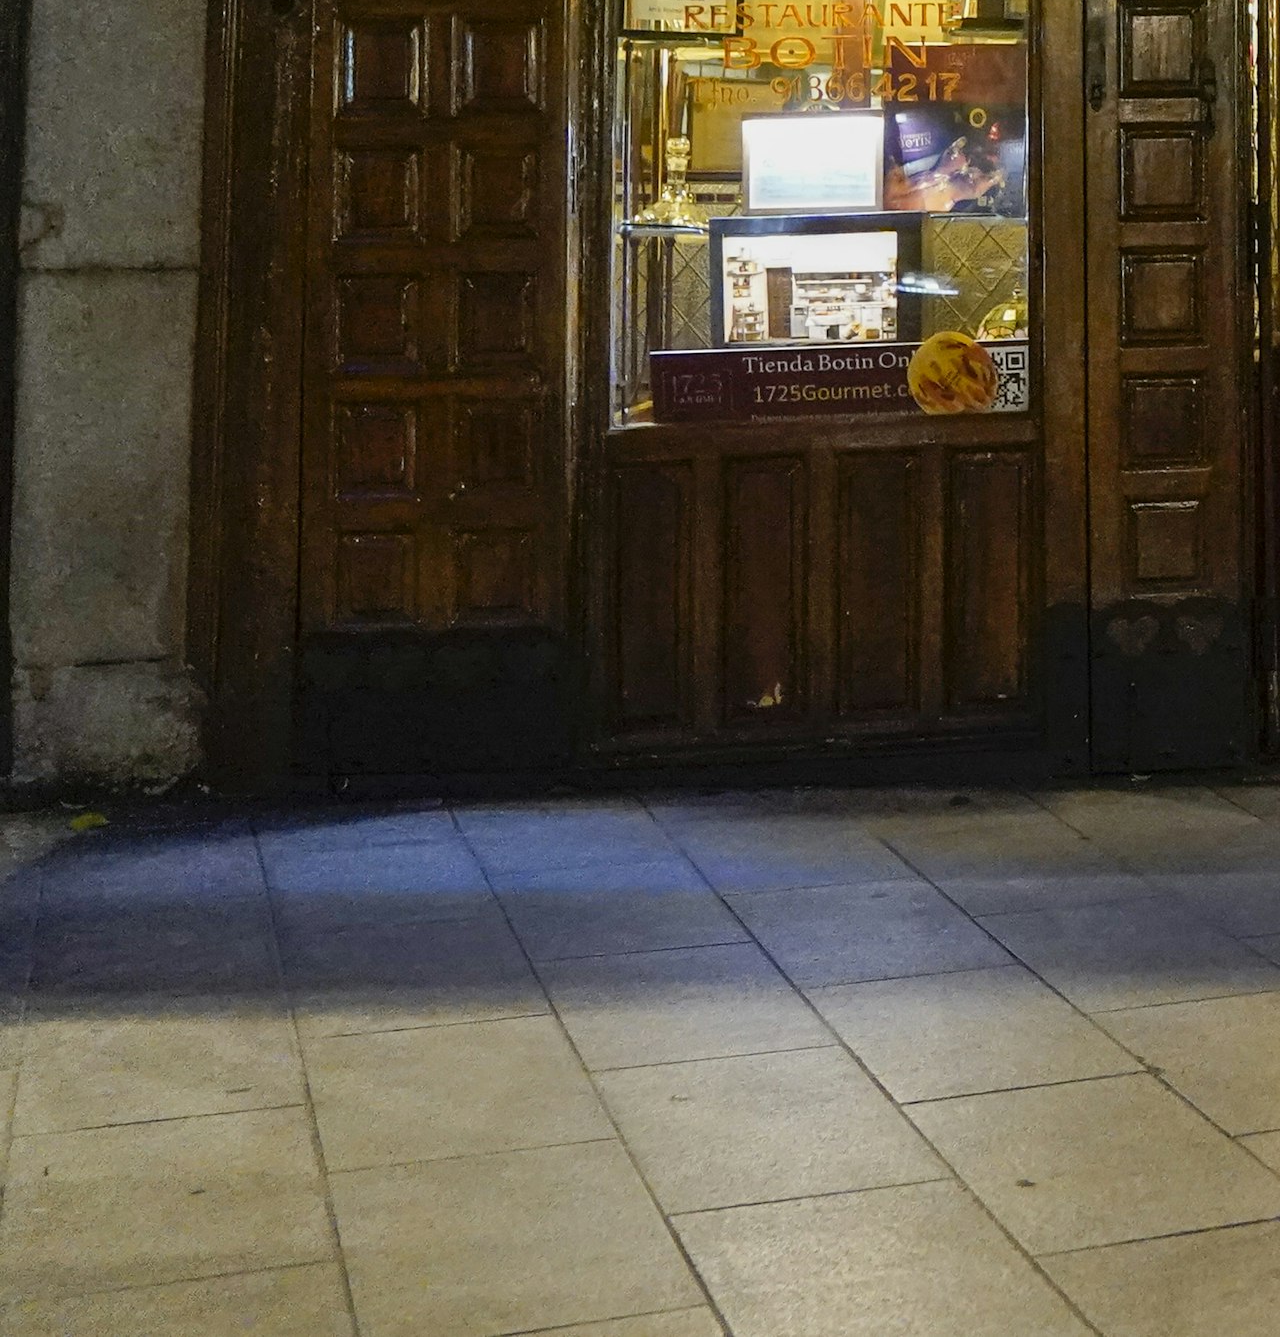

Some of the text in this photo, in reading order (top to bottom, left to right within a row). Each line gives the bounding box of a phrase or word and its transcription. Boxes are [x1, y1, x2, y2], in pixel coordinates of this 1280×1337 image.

[683, 2, 963, 31] RESTAURANTE
[723, 35, 928, 70] BOTIN
[743, 356, 814, 375] Tienda
